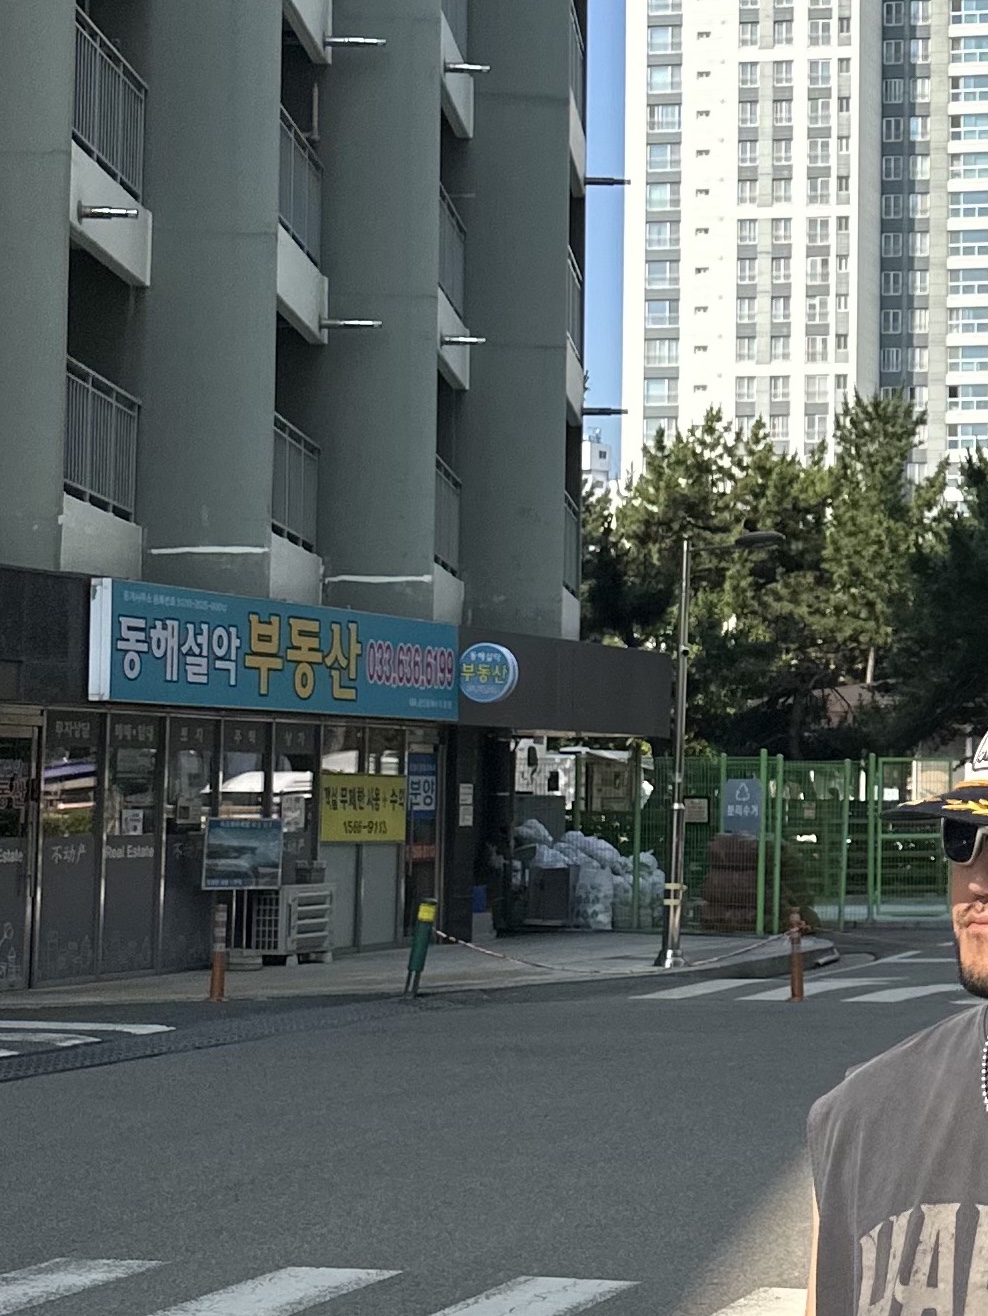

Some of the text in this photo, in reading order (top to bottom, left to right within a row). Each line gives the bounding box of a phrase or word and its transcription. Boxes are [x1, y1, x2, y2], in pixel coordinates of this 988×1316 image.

[117, 615, 241, 687] 동해설악
[244, 613, 363, 701] 부동산
[461, 663, 508, 684] 부동산
[410, 779, 436, 807] 분양
[105, 845, 154, 858] Real Estate
